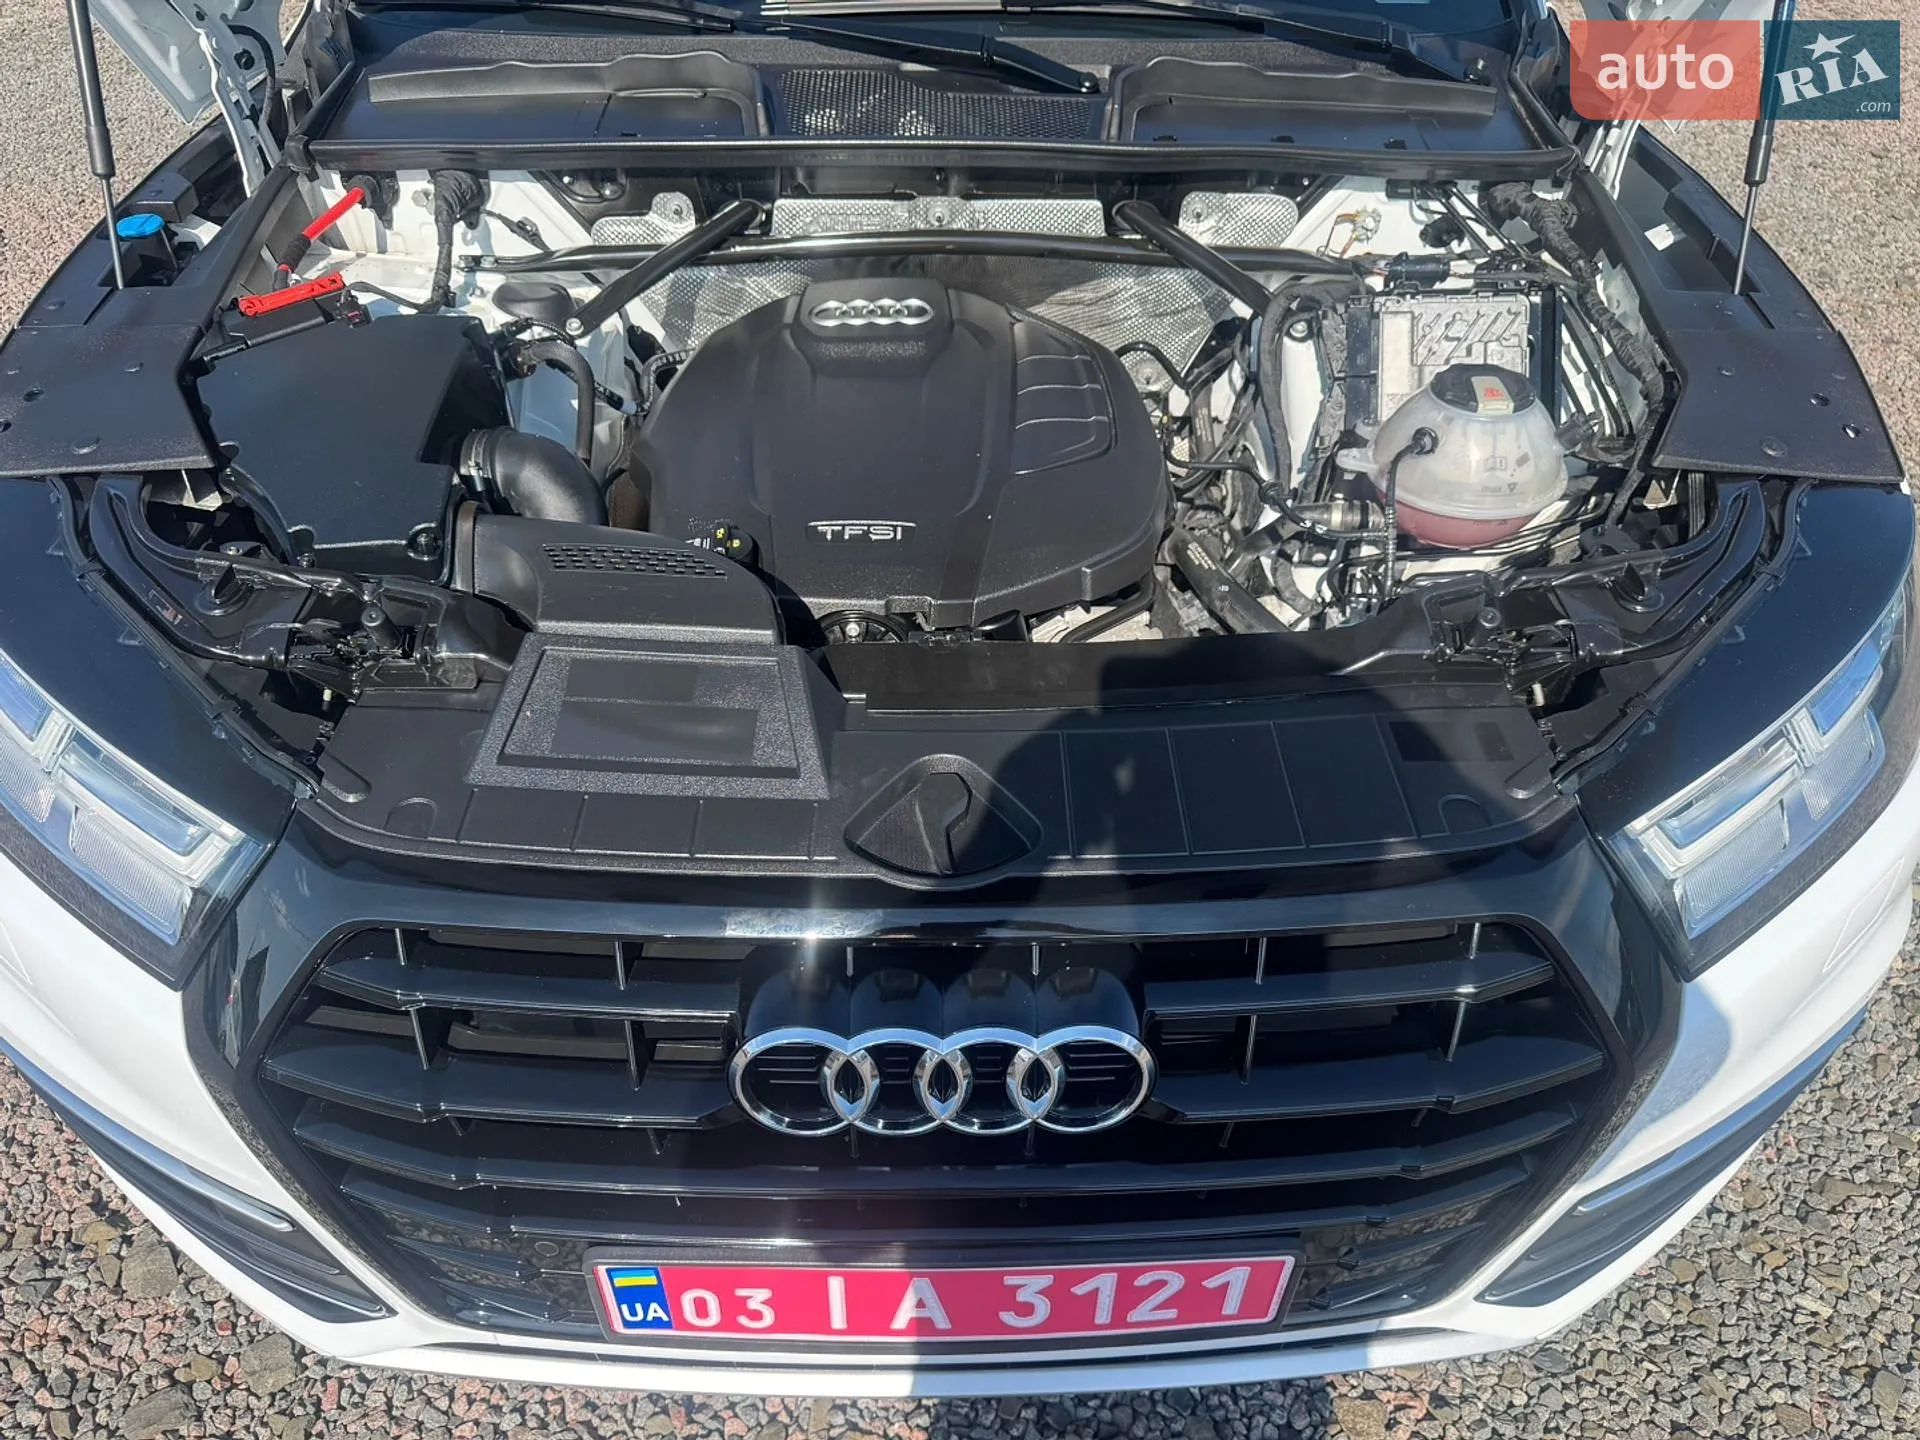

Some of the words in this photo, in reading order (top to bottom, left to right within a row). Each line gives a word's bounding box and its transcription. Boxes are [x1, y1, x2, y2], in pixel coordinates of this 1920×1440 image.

[816, 526, 902, 541] TFSI
[680, 1288, 776, 1328] 03
[998, 1266, 1251, 1328] 3121
[620, 1302, 670, 1322] UA
